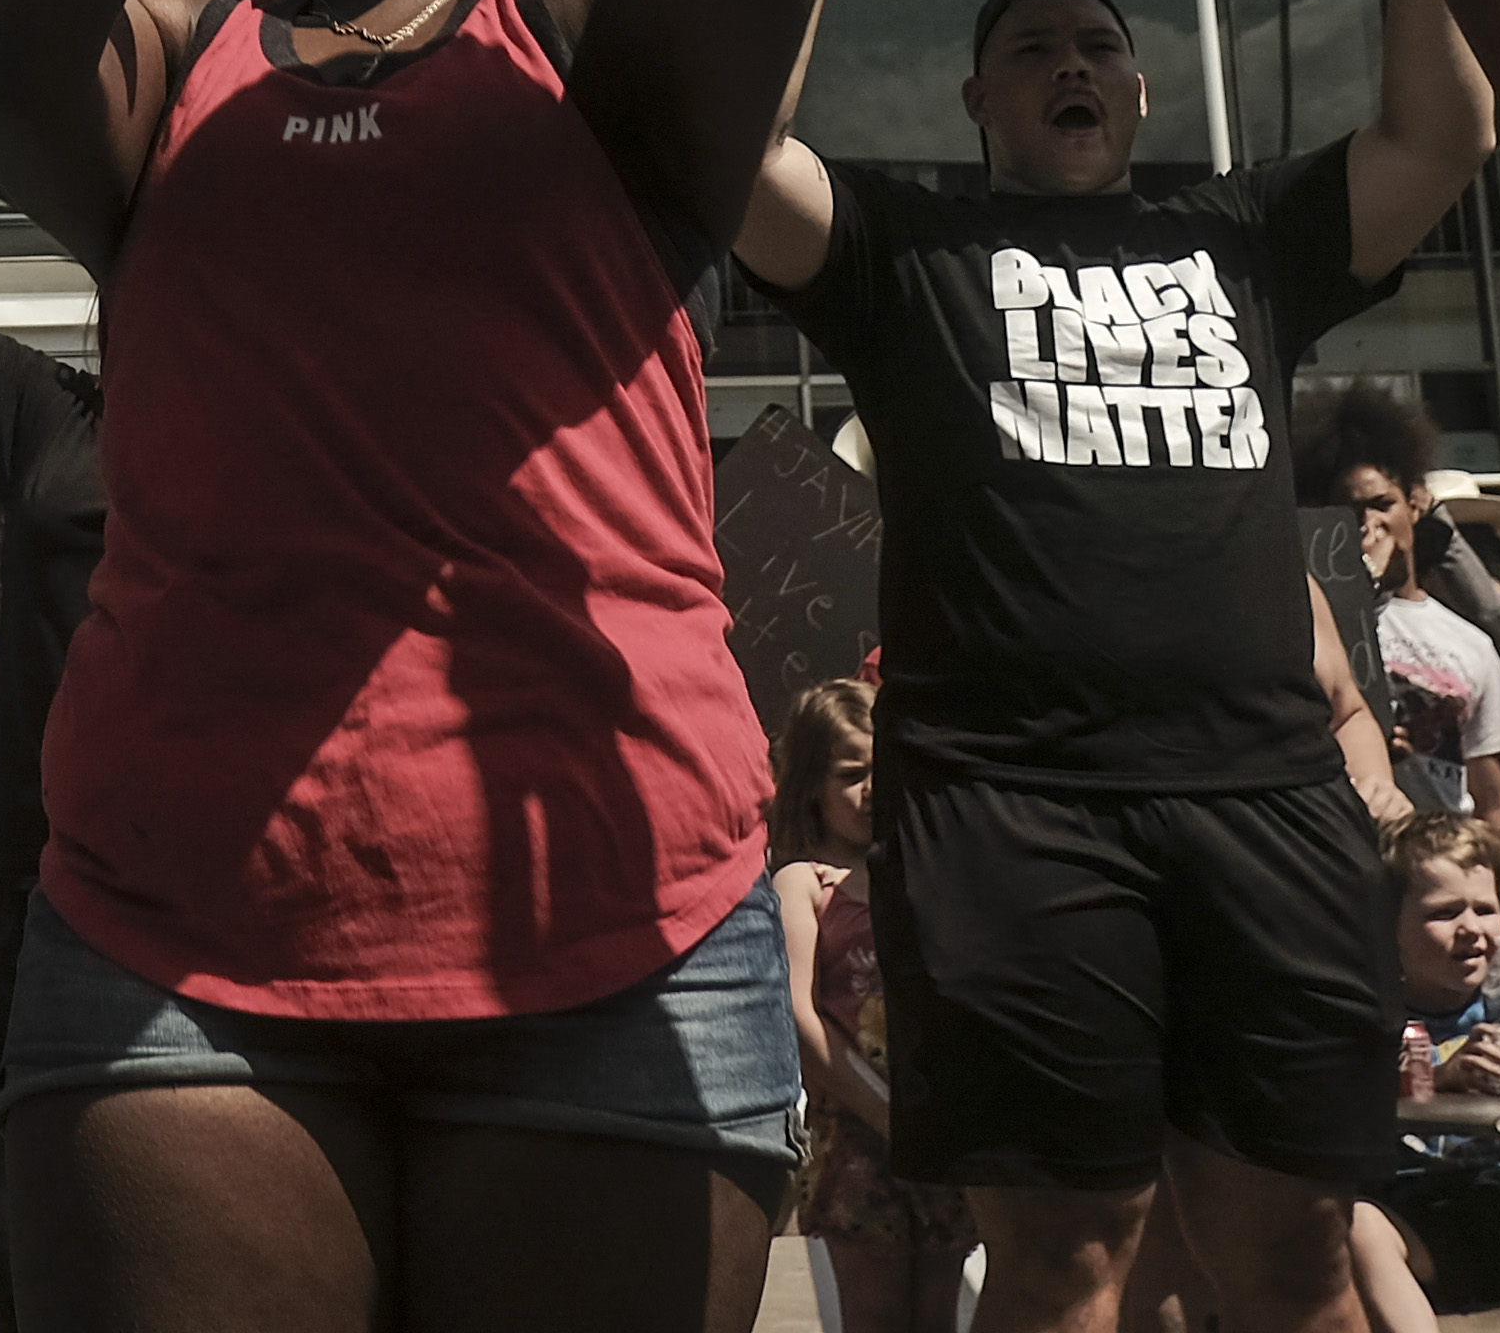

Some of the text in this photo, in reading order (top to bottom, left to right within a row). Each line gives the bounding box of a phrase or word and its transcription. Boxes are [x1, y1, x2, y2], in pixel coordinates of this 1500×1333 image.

[282, 102, 382, 144] PINK
[990, 247, 1237, 326] BLACK
[1004, 308, 1251, 388] LIVES
[989, 380, 1271, 470] MATTER
